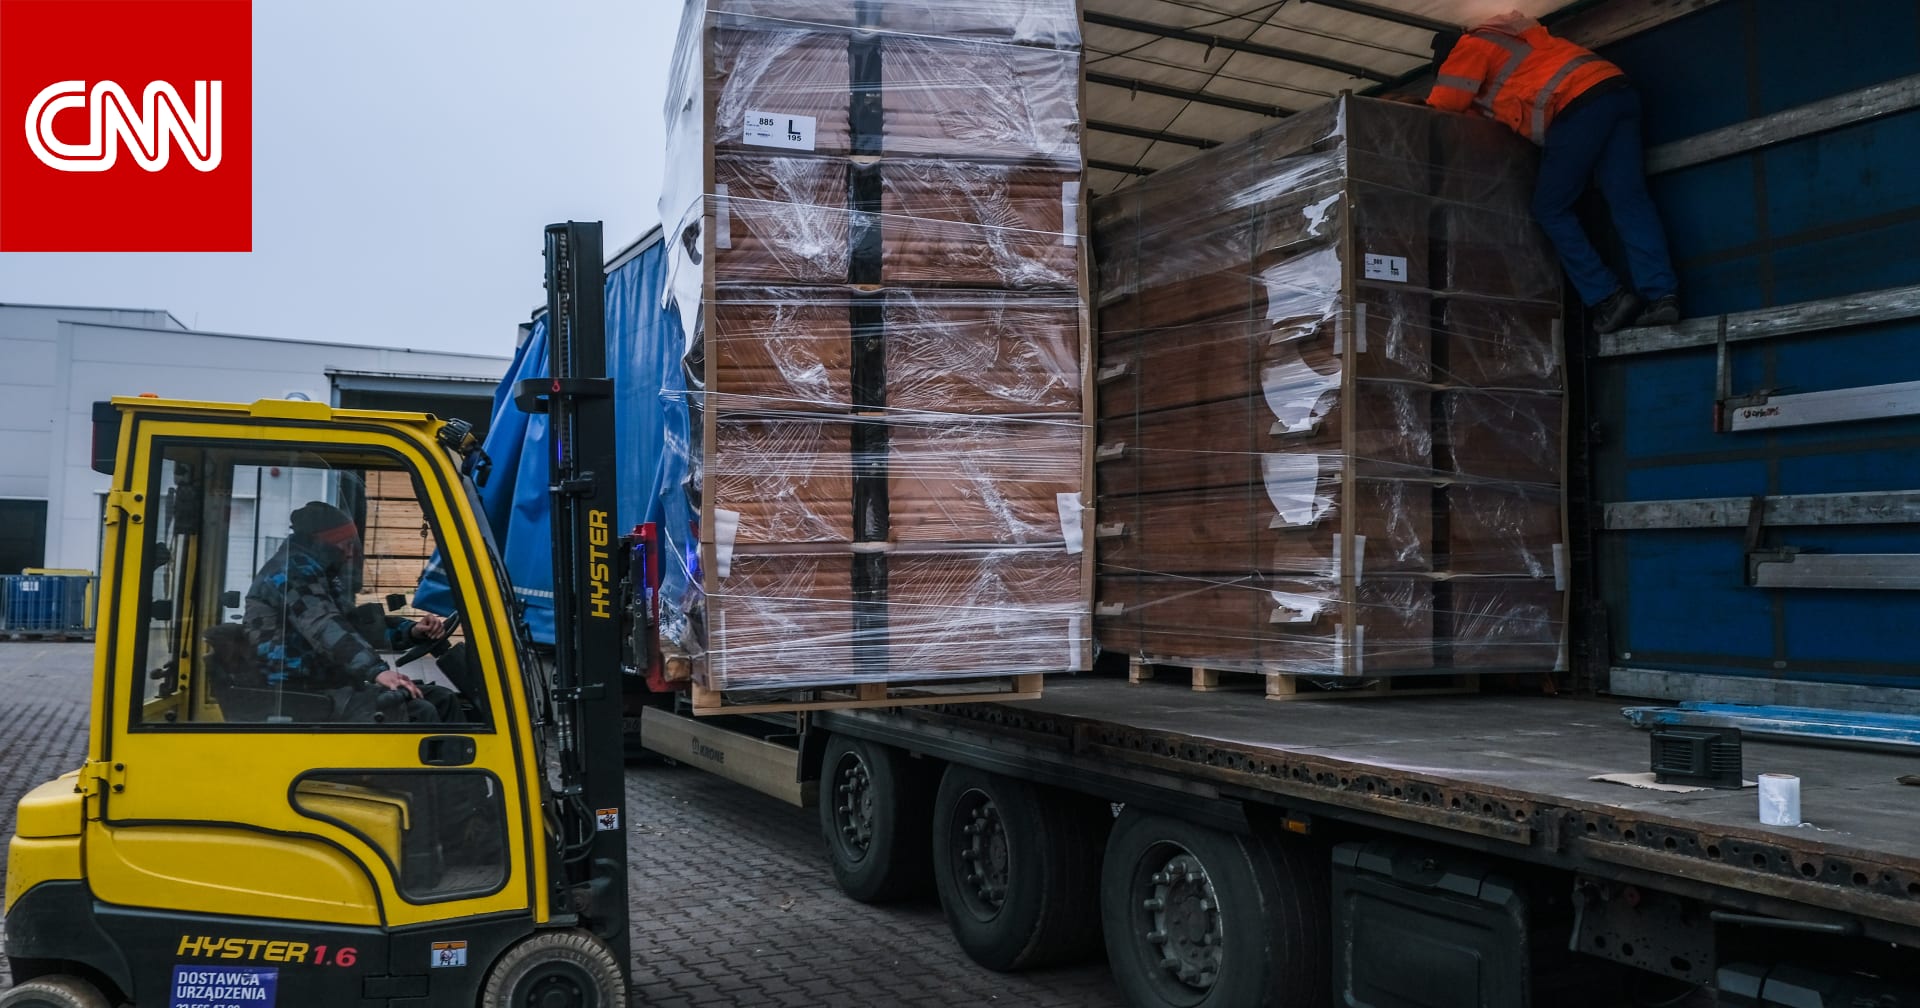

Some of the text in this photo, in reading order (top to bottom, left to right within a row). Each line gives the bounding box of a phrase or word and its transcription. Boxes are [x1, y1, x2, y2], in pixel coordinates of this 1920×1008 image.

[759, 118, 774, 126] 885
[788, 120, 800, 134] L
[589, 509, 610, 618] HYSTER
[176, 935, 358, 968] HYSTER 1.6
[177, 971, 261, 987] DOSTAWCA
[176, 985, 267, 1002] URZĄDZENIA
